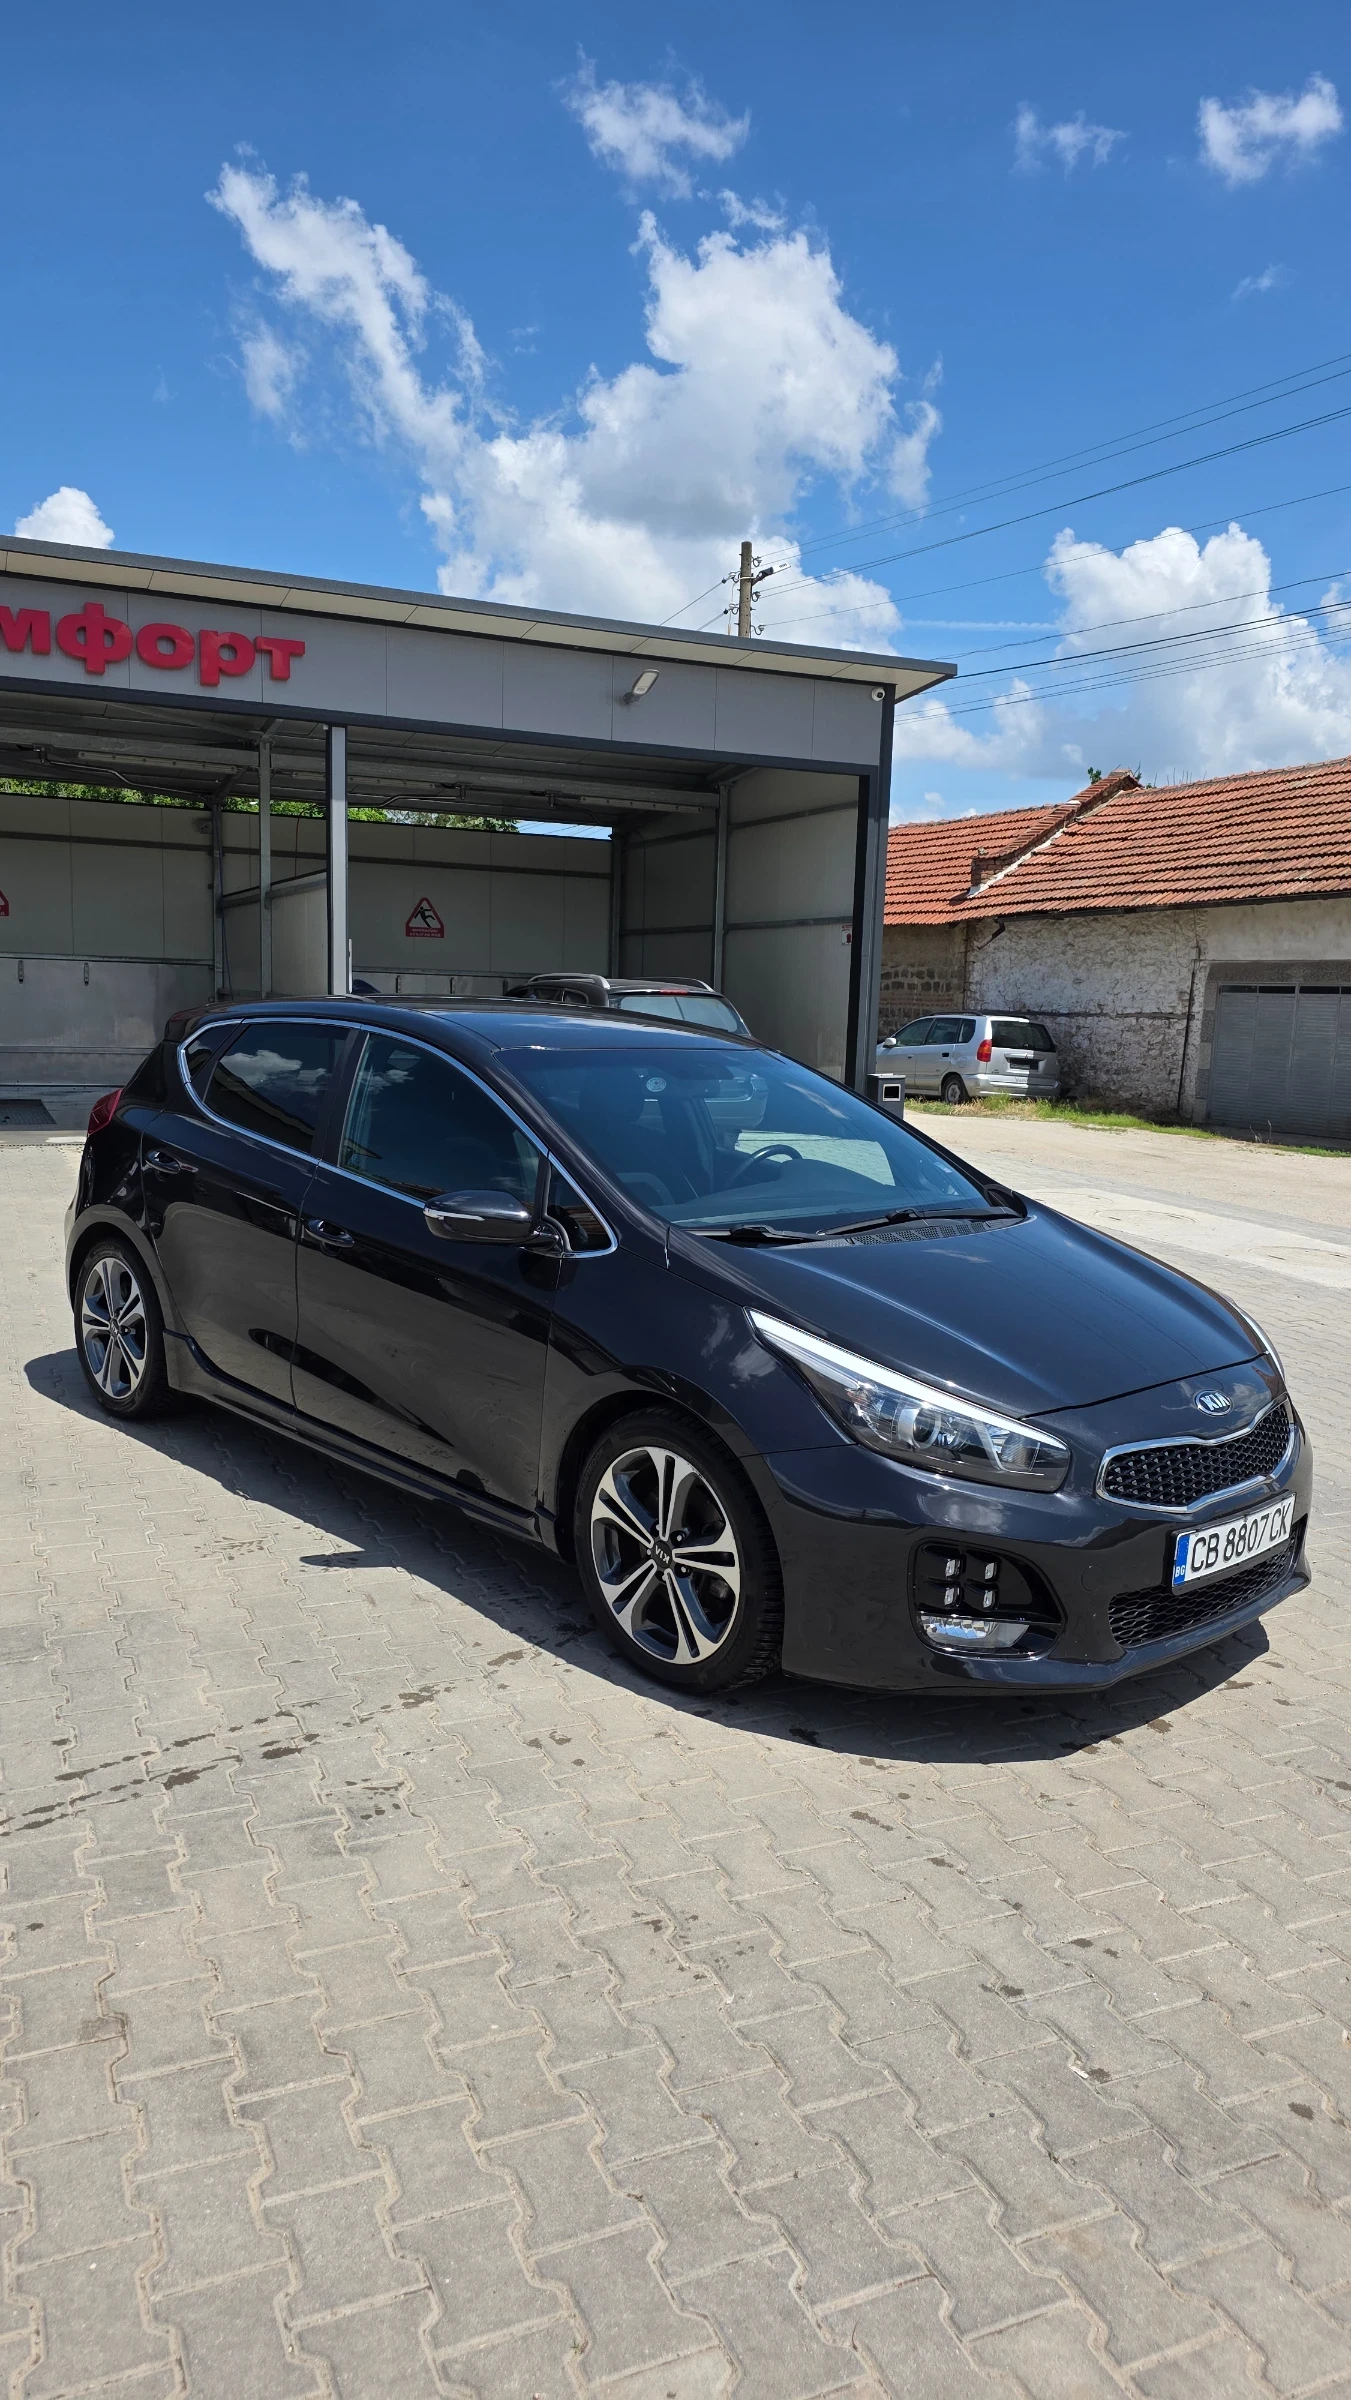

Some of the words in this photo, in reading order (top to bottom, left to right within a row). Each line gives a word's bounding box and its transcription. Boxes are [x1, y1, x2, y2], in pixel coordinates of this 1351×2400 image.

[1200, 1392, 1230, 1411] KIA
[1191, 1532, 1220, 1573] CB
[1223, 1512, 1270, 1563] 8807
[1269, 1501, 1292, 1542] CK
[655, 1544, 670, 1564] KIA
[1175, 1564, 1186, 1578] BG
